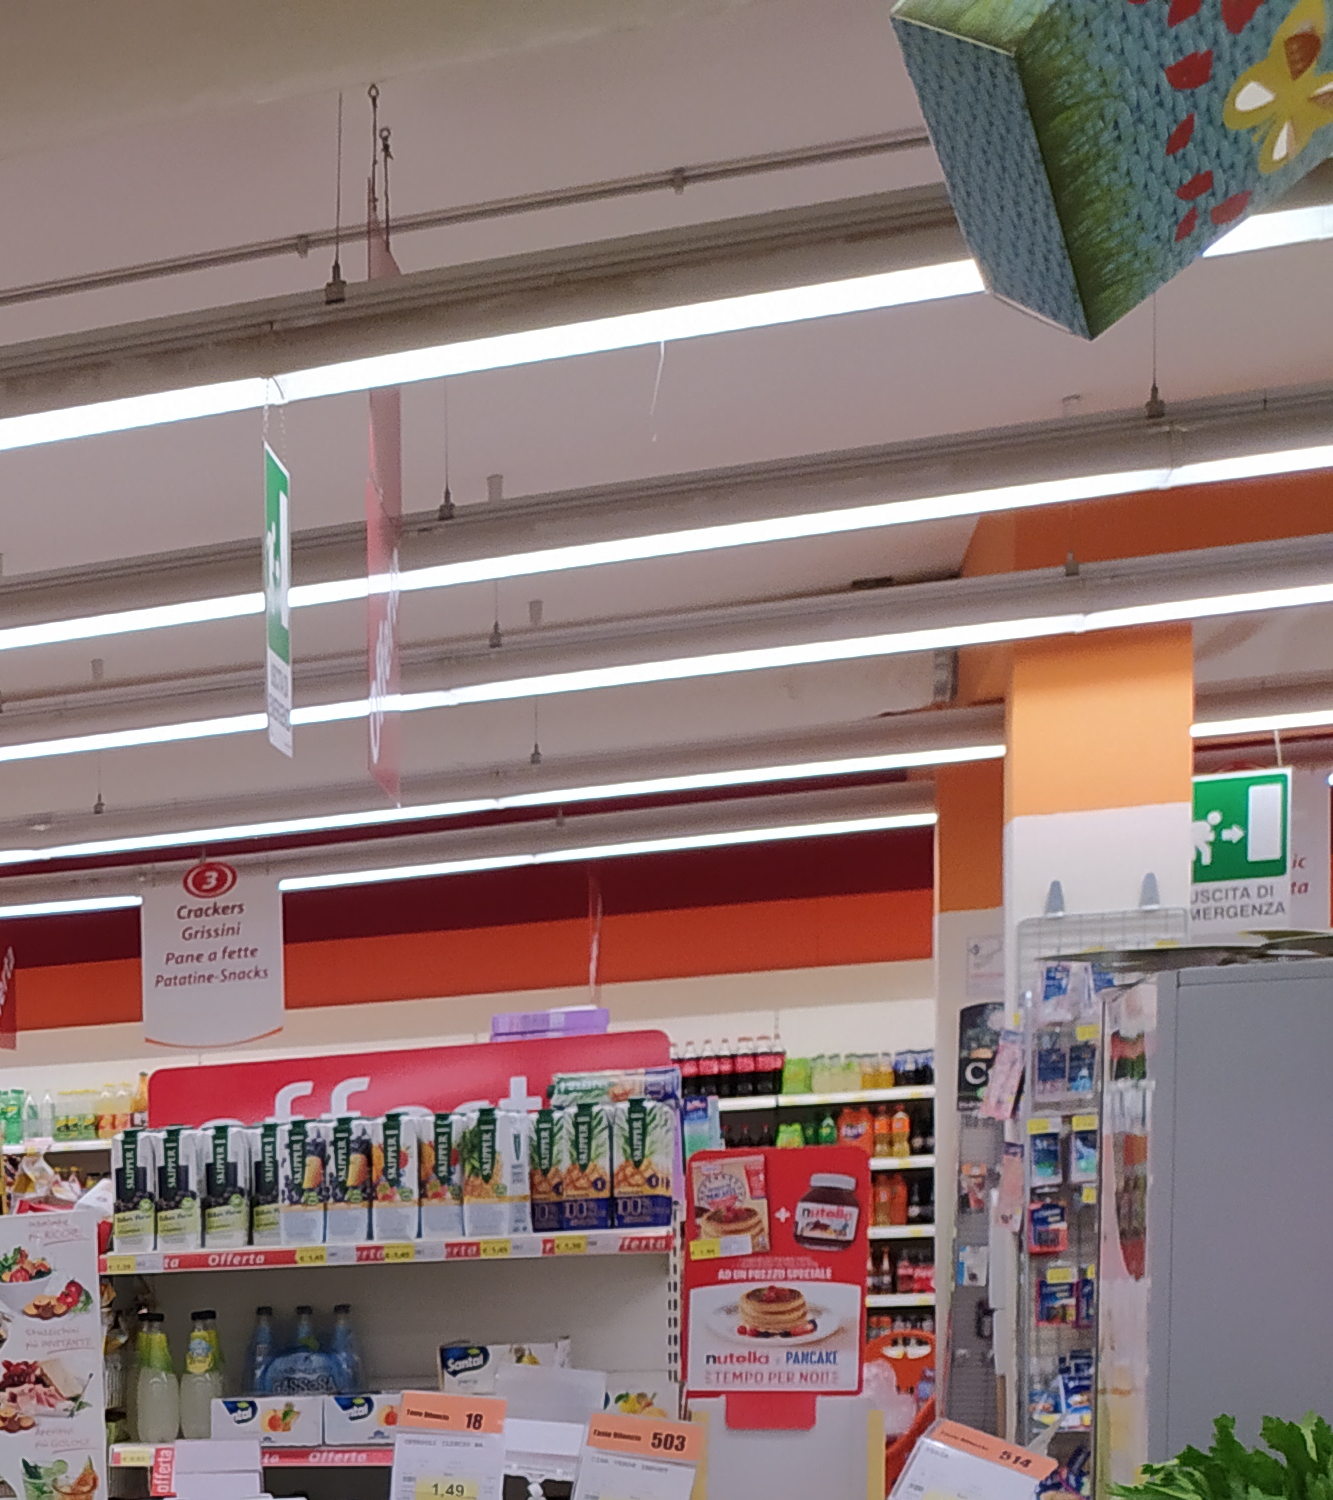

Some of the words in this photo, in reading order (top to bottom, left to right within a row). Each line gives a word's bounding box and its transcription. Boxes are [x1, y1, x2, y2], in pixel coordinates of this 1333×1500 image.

[201, 871, 219, 890] 3
[1256, 884, 1275, 900] DI
[175, 900, 245, 921] Crackers
[1191, 901, 1287, 922] MERGENZA
[180, 922, 242, 942] Grissini
[164, 951, 205, 967] Pane
[207, 949, 218, 962] a
[220, 945, 259, 961] fette
[154, 966, 270, 989] Patatine-Snacks
[207, 1252, 266, 1268] Offerta
[446, 1355, 485, 1372] Santal
[704, 1350, 770, 1366] nutella
[464, 1412, 485, 1431] 18
[650, 1432, 687, 1453] 503
[998, 1450, 1033, 1469] 514
[154, 1449, 173, 1494] offerta
[432, 1482, 466, 1499] 1,49
